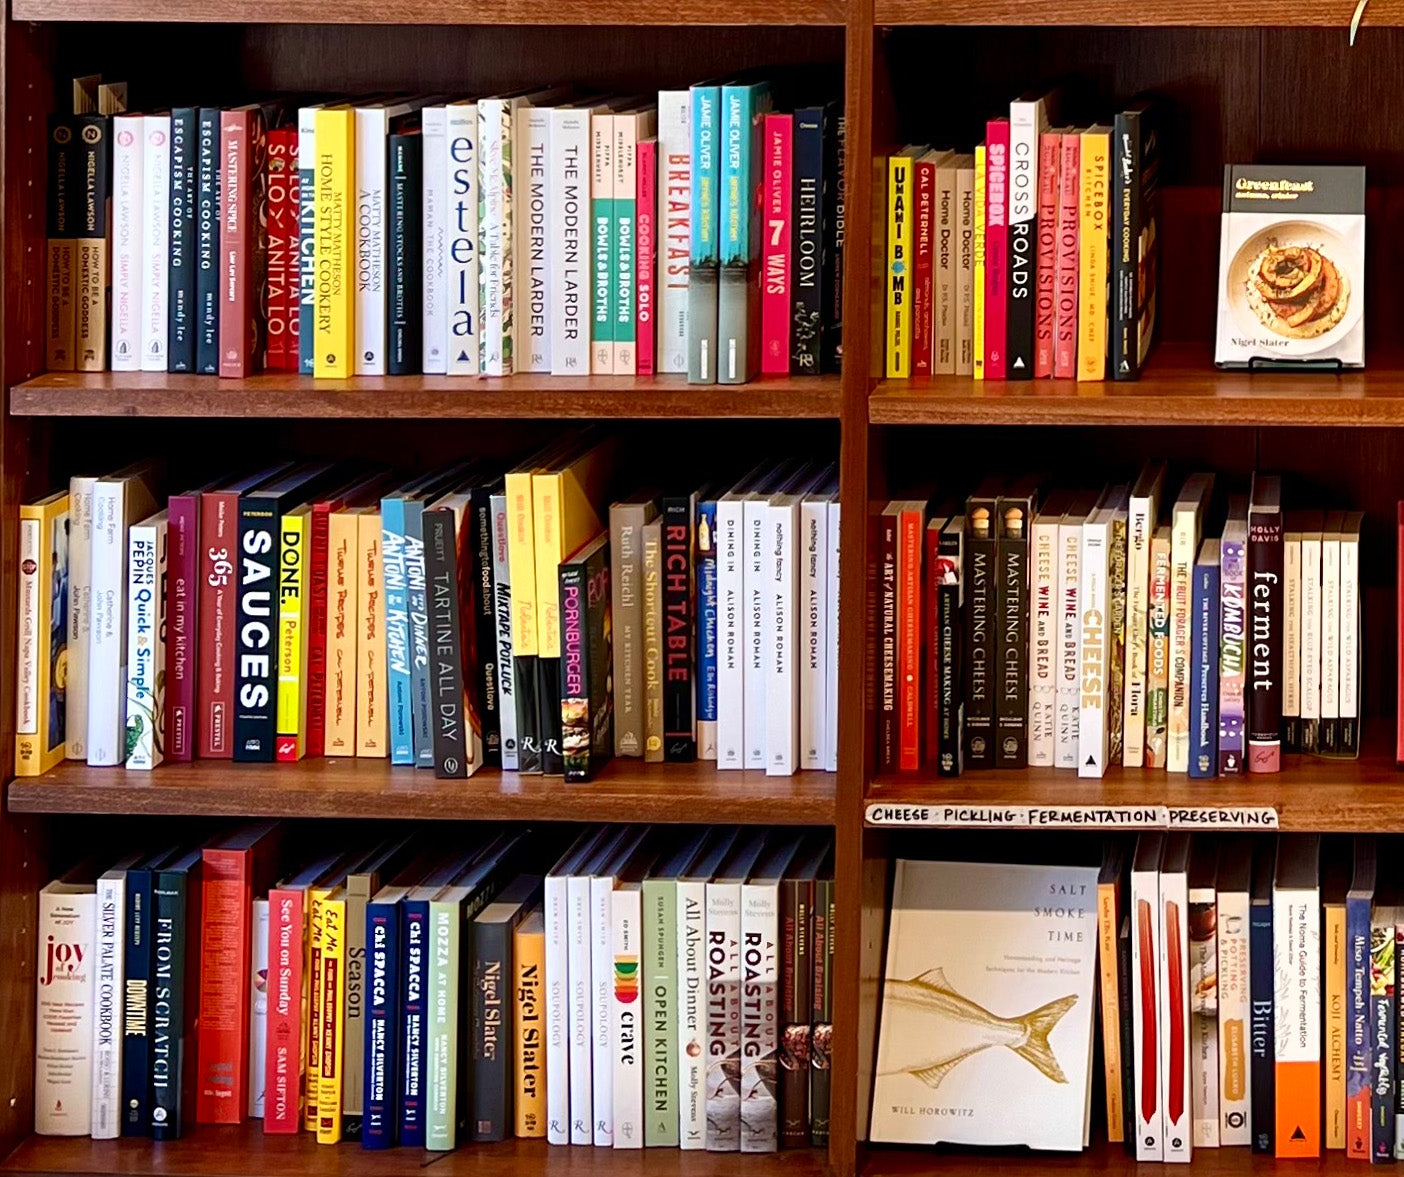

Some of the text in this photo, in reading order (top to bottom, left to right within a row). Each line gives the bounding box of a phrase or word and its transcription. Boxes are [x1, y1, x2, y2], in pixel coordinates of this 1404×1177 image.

[989, 144, 1005, 226] SPICEBOX
[451, 136, 474, 336] estela
[564, 145, 578, 339] THE MODERN LARDER
[800, 178, 815, 287] HEIRLOOM
[1038, 204, 1055, 341] PROVISIONS
[1250, 526, 1280, 534] HOLLY
[774, 557, 784, 582] fancy
[240, 530, 272, 708] SAUCES
[667, 526, 687, 681] RICH TABLE
[776, 594, 784, 632] ALISON
[1254, 572, 1278, 691] ferment
[283, 621, 297, 673] Peterson
[564, 587, 581, 695] PORNBURGER
[776, 635, 784, 674] ROMAN
[1081, 609, 1102, 709] CHEESE
[872, 809, 1276, 824] CHEESE PICKLING FERMENTATION PRESERVING
[1033, 907, 1085, 919] SMOKE
[1049, 884, 1088, 895] SALT
[1047, 931, 1084, 942] TIME
[125, 979, 147, 1036] DOWNTIME
[348, 947, 365, 1019] Season
[709, 931, 726, 1057] ROASTING
[518, 964, 539, 1098] Nigel Slater
[621, 1011, 635, 1065] crave
[1252, 1001, 1272, 1058] Bitter
[892, 1105, 975, 1117] WILL HOROWITZ
